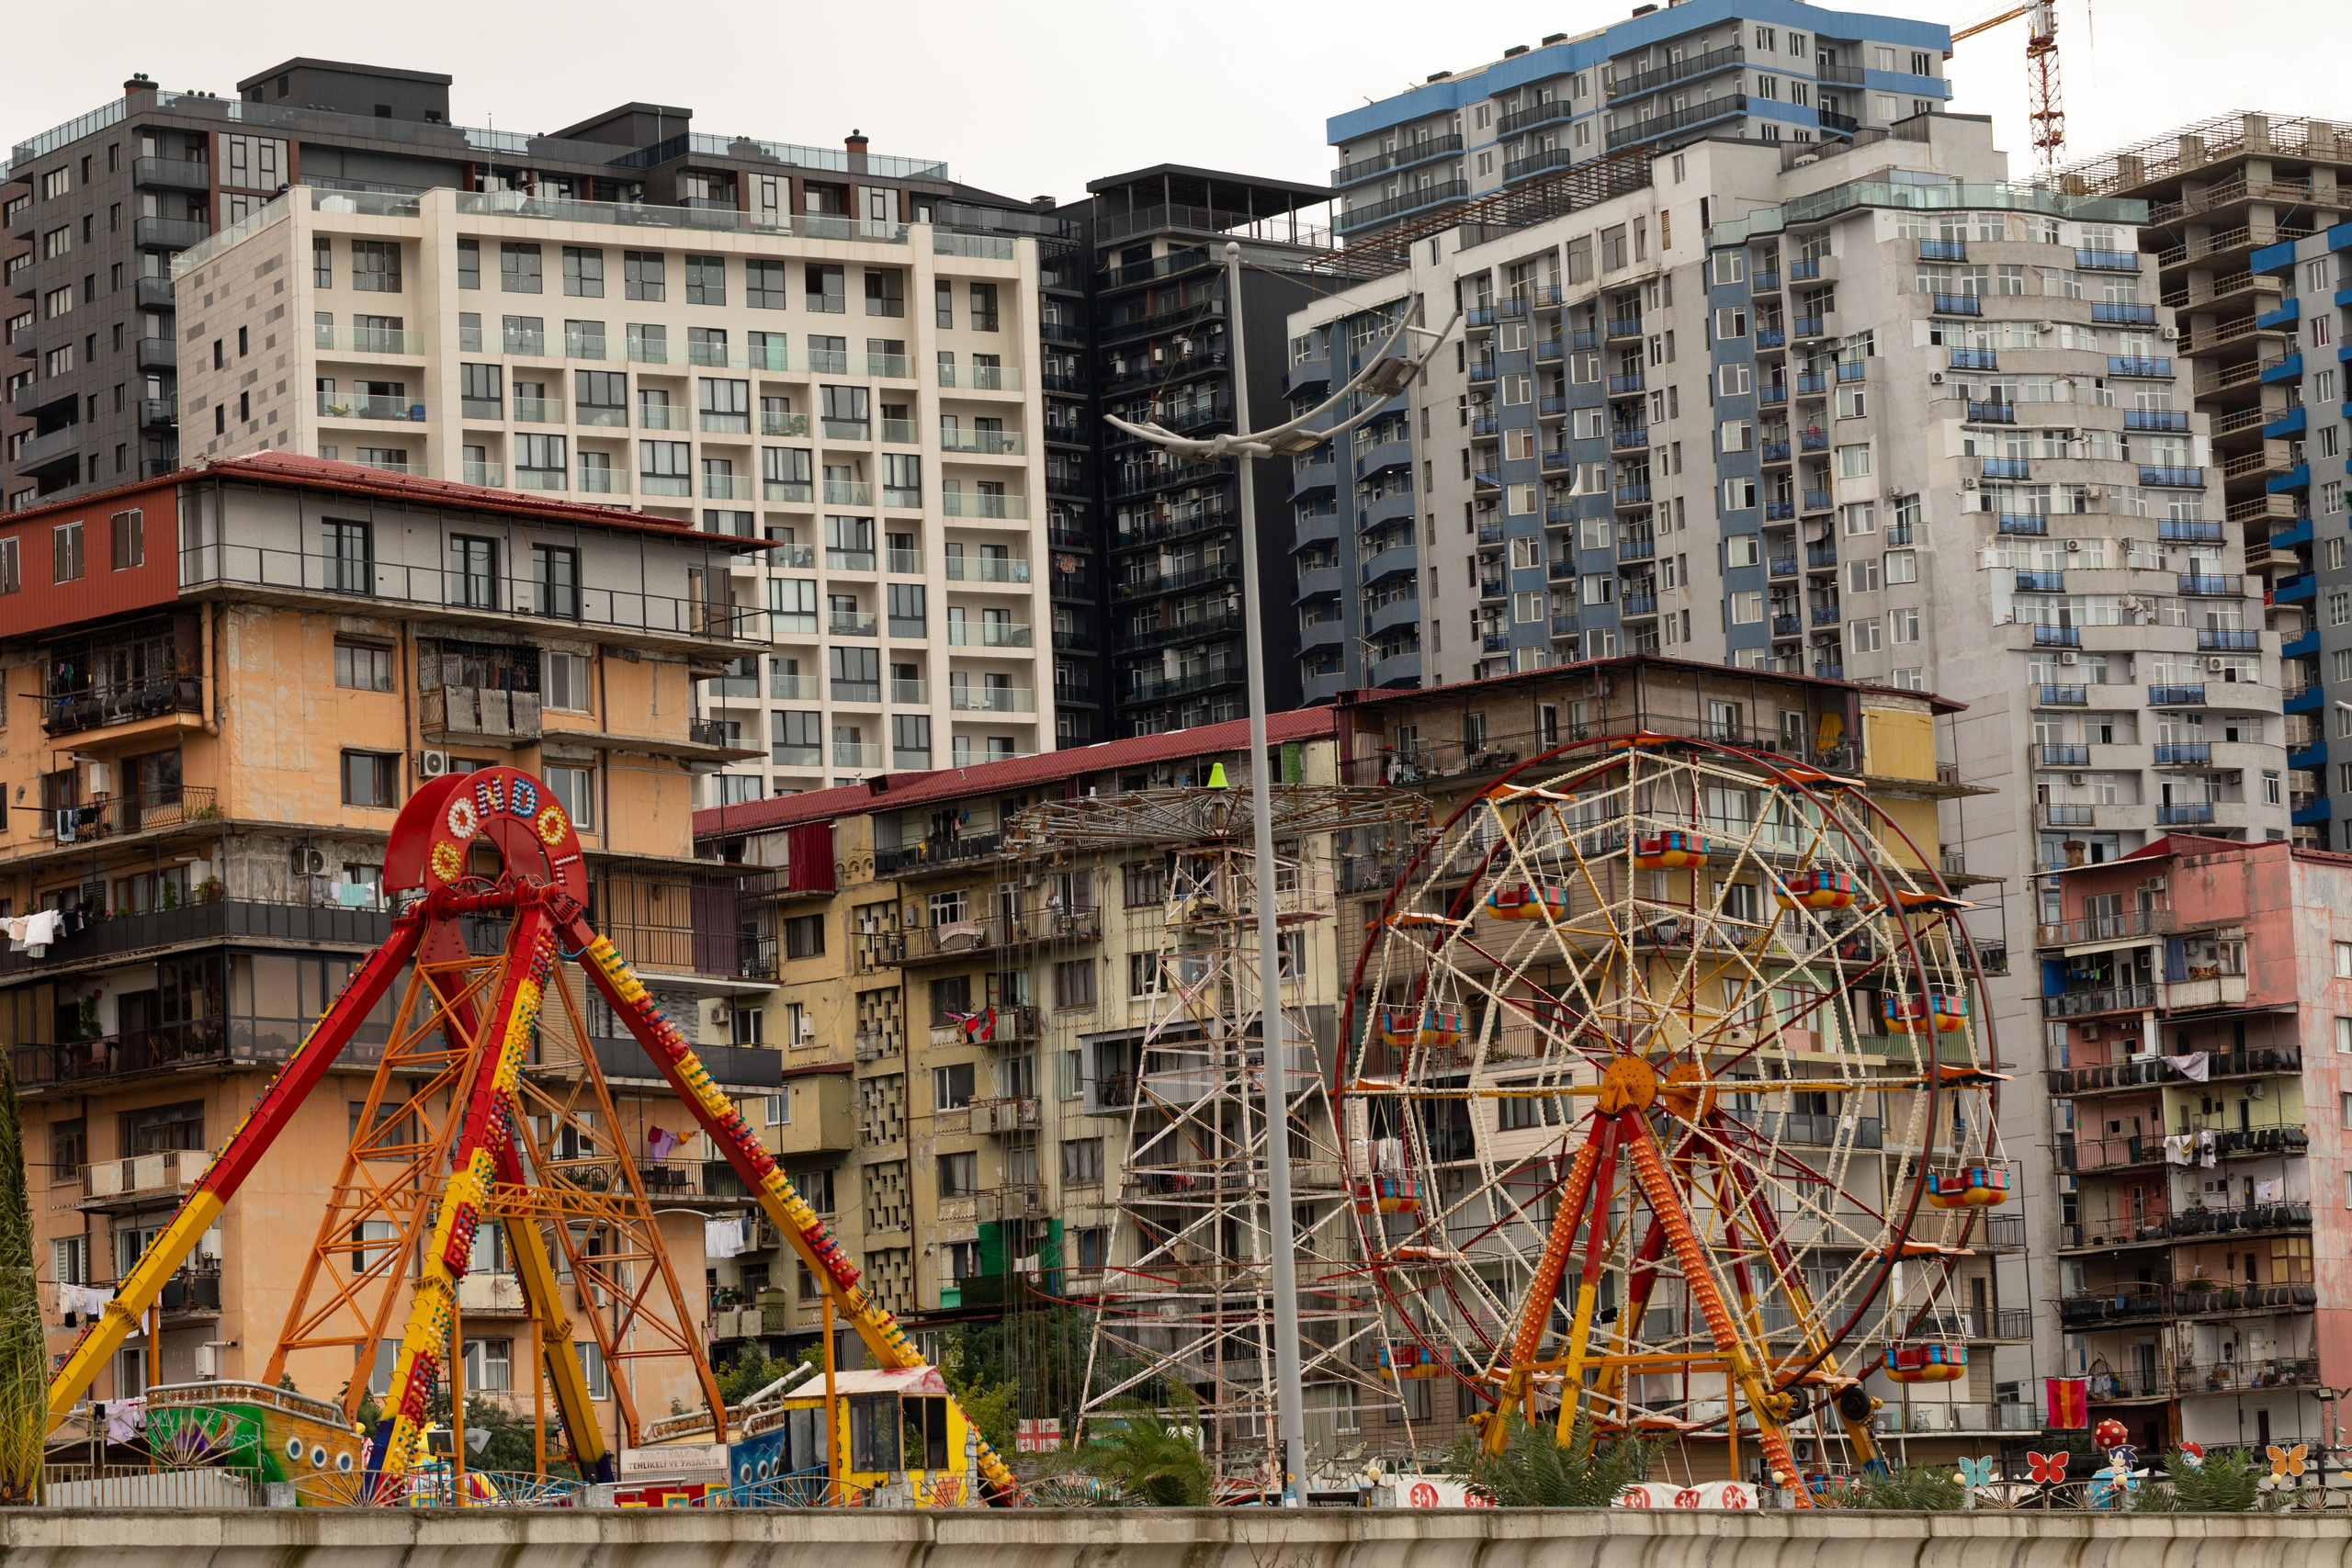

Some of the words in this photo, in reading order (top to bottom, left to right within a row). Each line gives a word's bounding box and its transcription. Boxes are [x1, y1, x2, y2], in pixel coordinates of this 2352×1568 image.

[432, 774, 581, 886] GONDOL
[669, 1460, 679, 1468] VE
[681, 1458, 720, 1468] YASAKTIR
[1415, 1488, 1433, 1507] 3+1
[1725, 1489, 1742, 1508] 3+1
